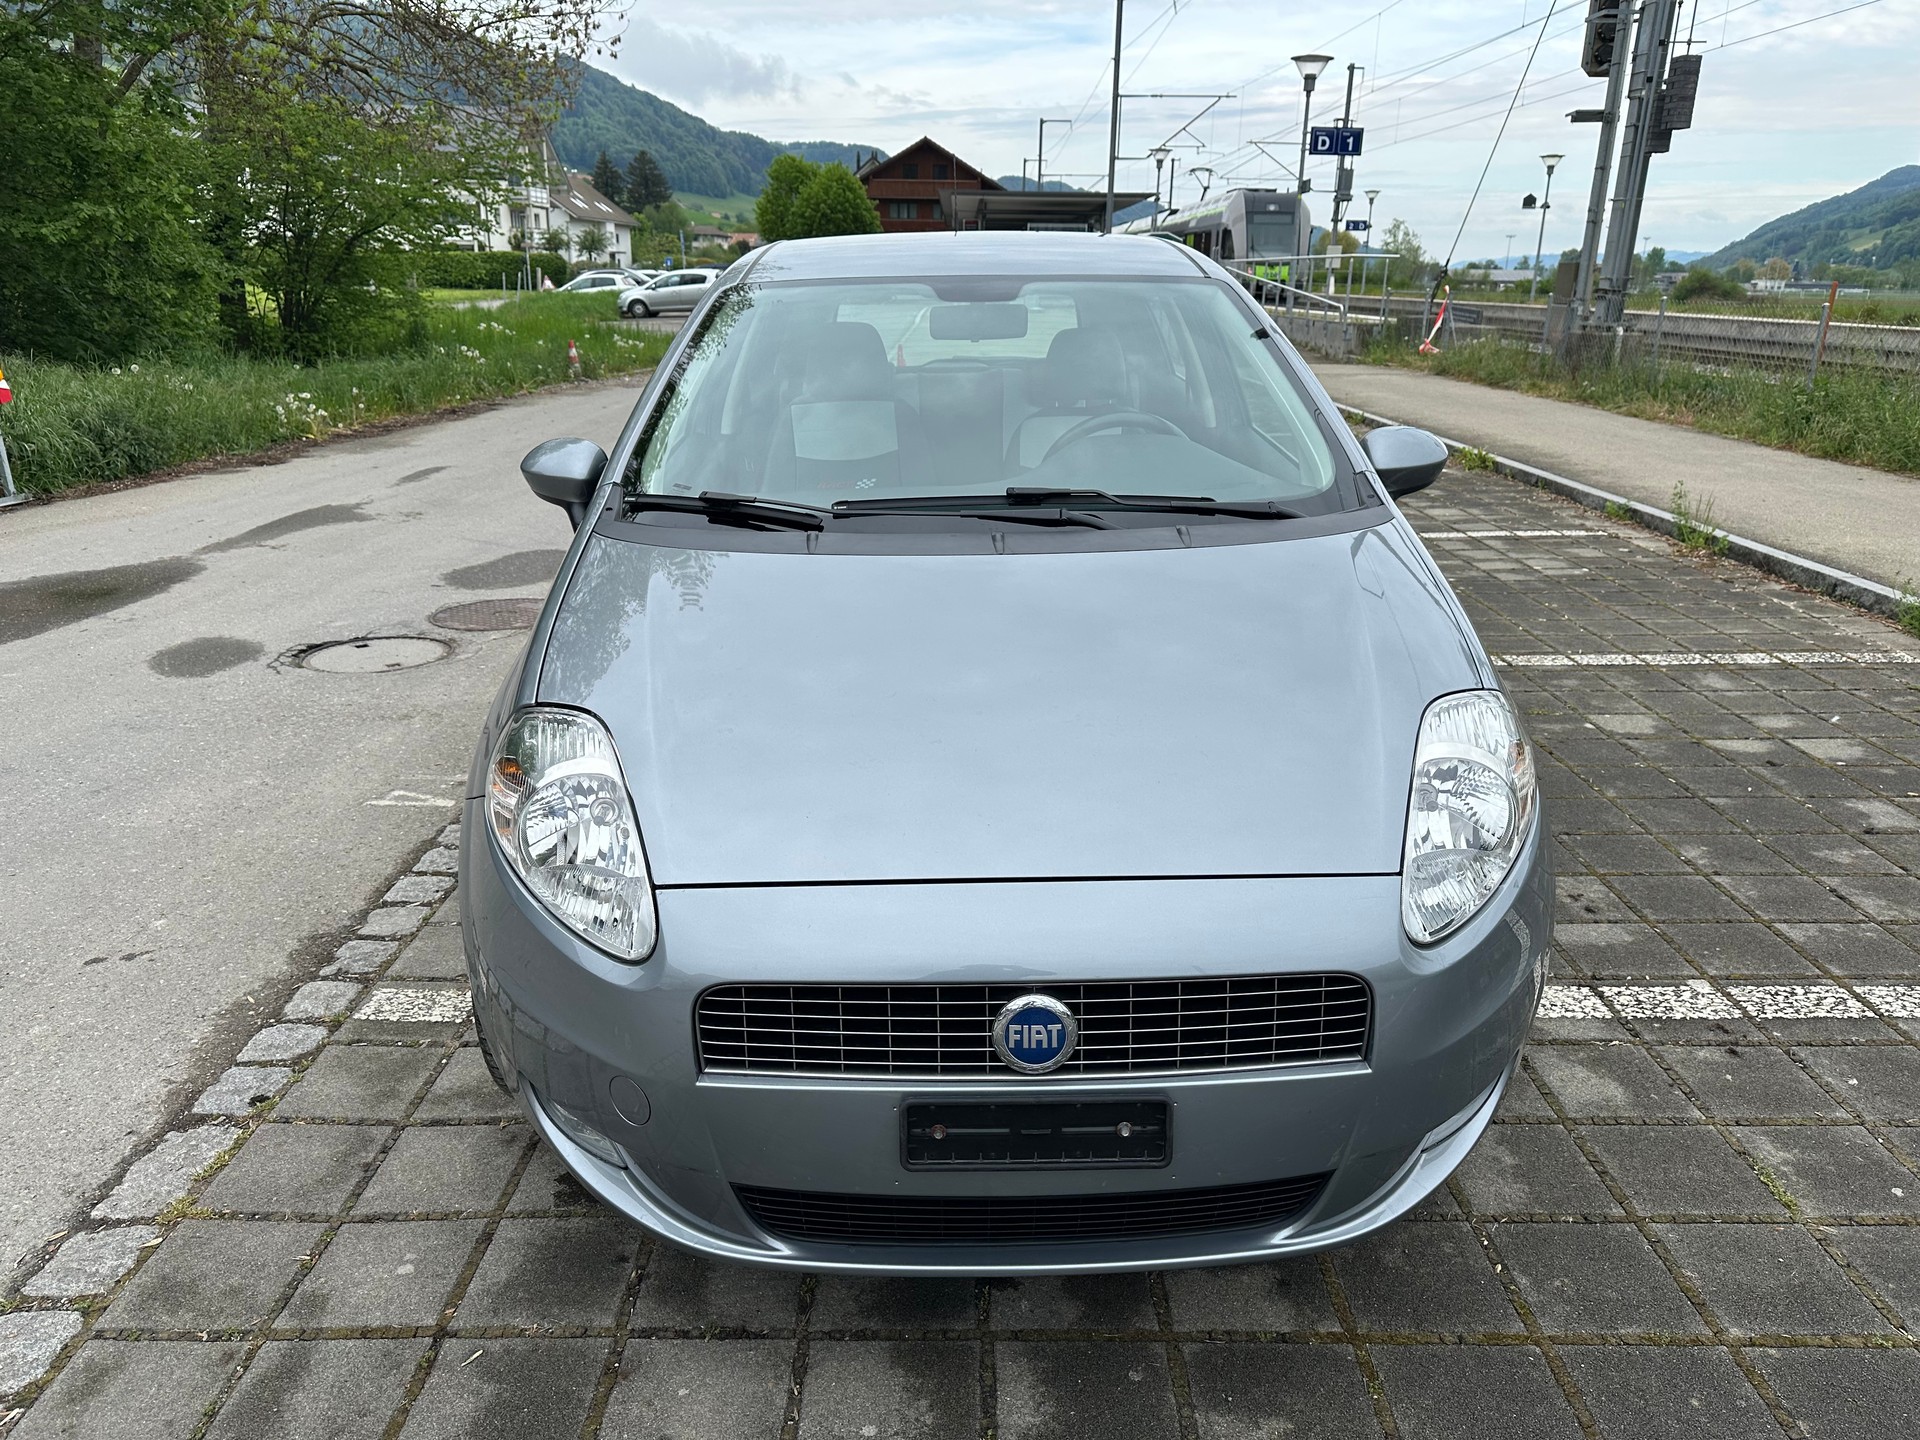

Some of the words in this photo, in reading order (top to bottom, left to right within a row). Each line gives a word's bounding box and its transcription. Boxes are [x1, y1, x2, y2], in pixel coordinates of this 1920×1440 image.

[1317, 135, 1330, 151] D
[1346, 136, 1354, 152] 1
[1008, 1024, 1062, 1049] FIAT
